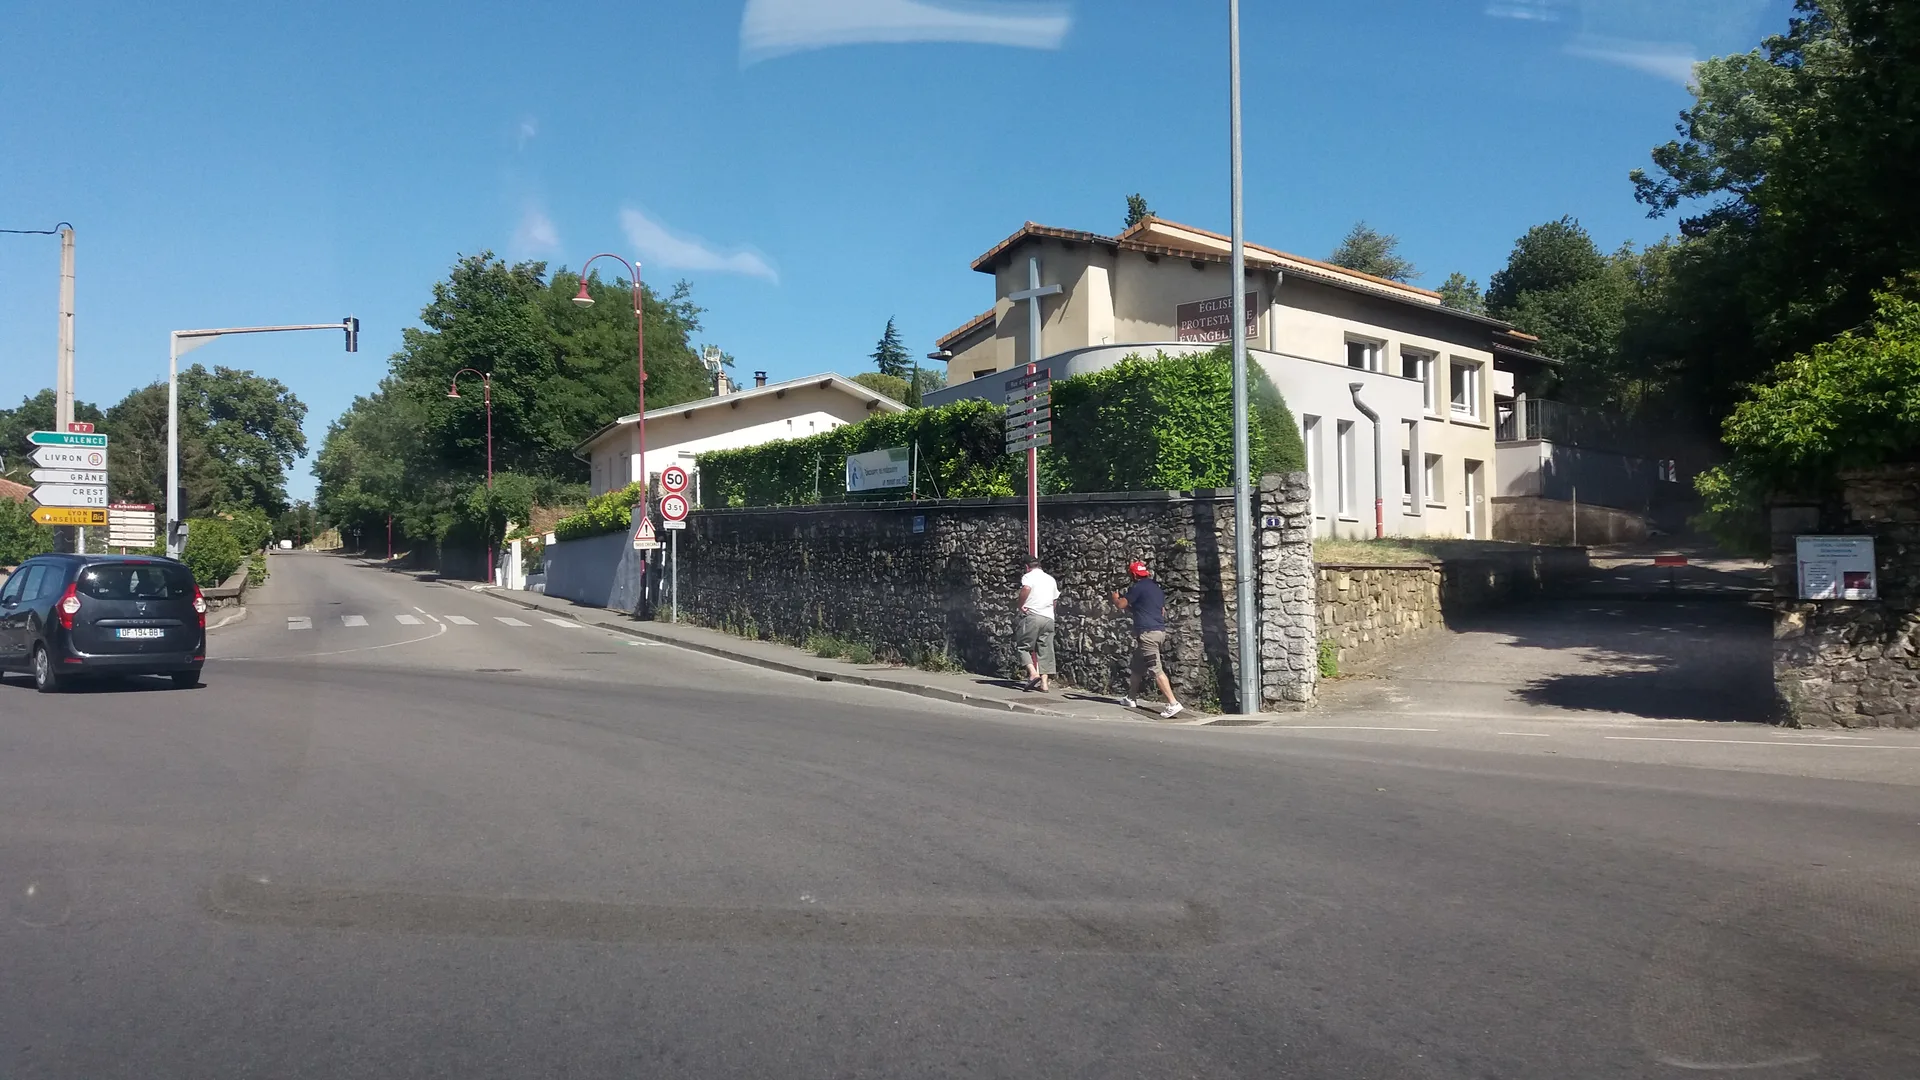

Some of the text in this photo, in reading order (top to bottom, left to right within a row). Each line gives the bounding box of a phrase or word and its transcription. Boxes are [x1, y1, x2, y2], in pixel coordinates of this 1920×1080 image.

[1199, 299, 1233, 313] ÉGLISE
[1181, 310, 1253, 330] PROTESTAE
[1180, 325, 1256, 343] ÉVANGÉLIE
[64, 436, 103, 444] VALENCE
[45, 454, 82, 462] LIVRON
[70, 473, 104, 482] GRÂNE
[667, 473, 683, 485] 50
[72, 488, 103, 496] CREST
[92, 513, 103, 521] Bis
